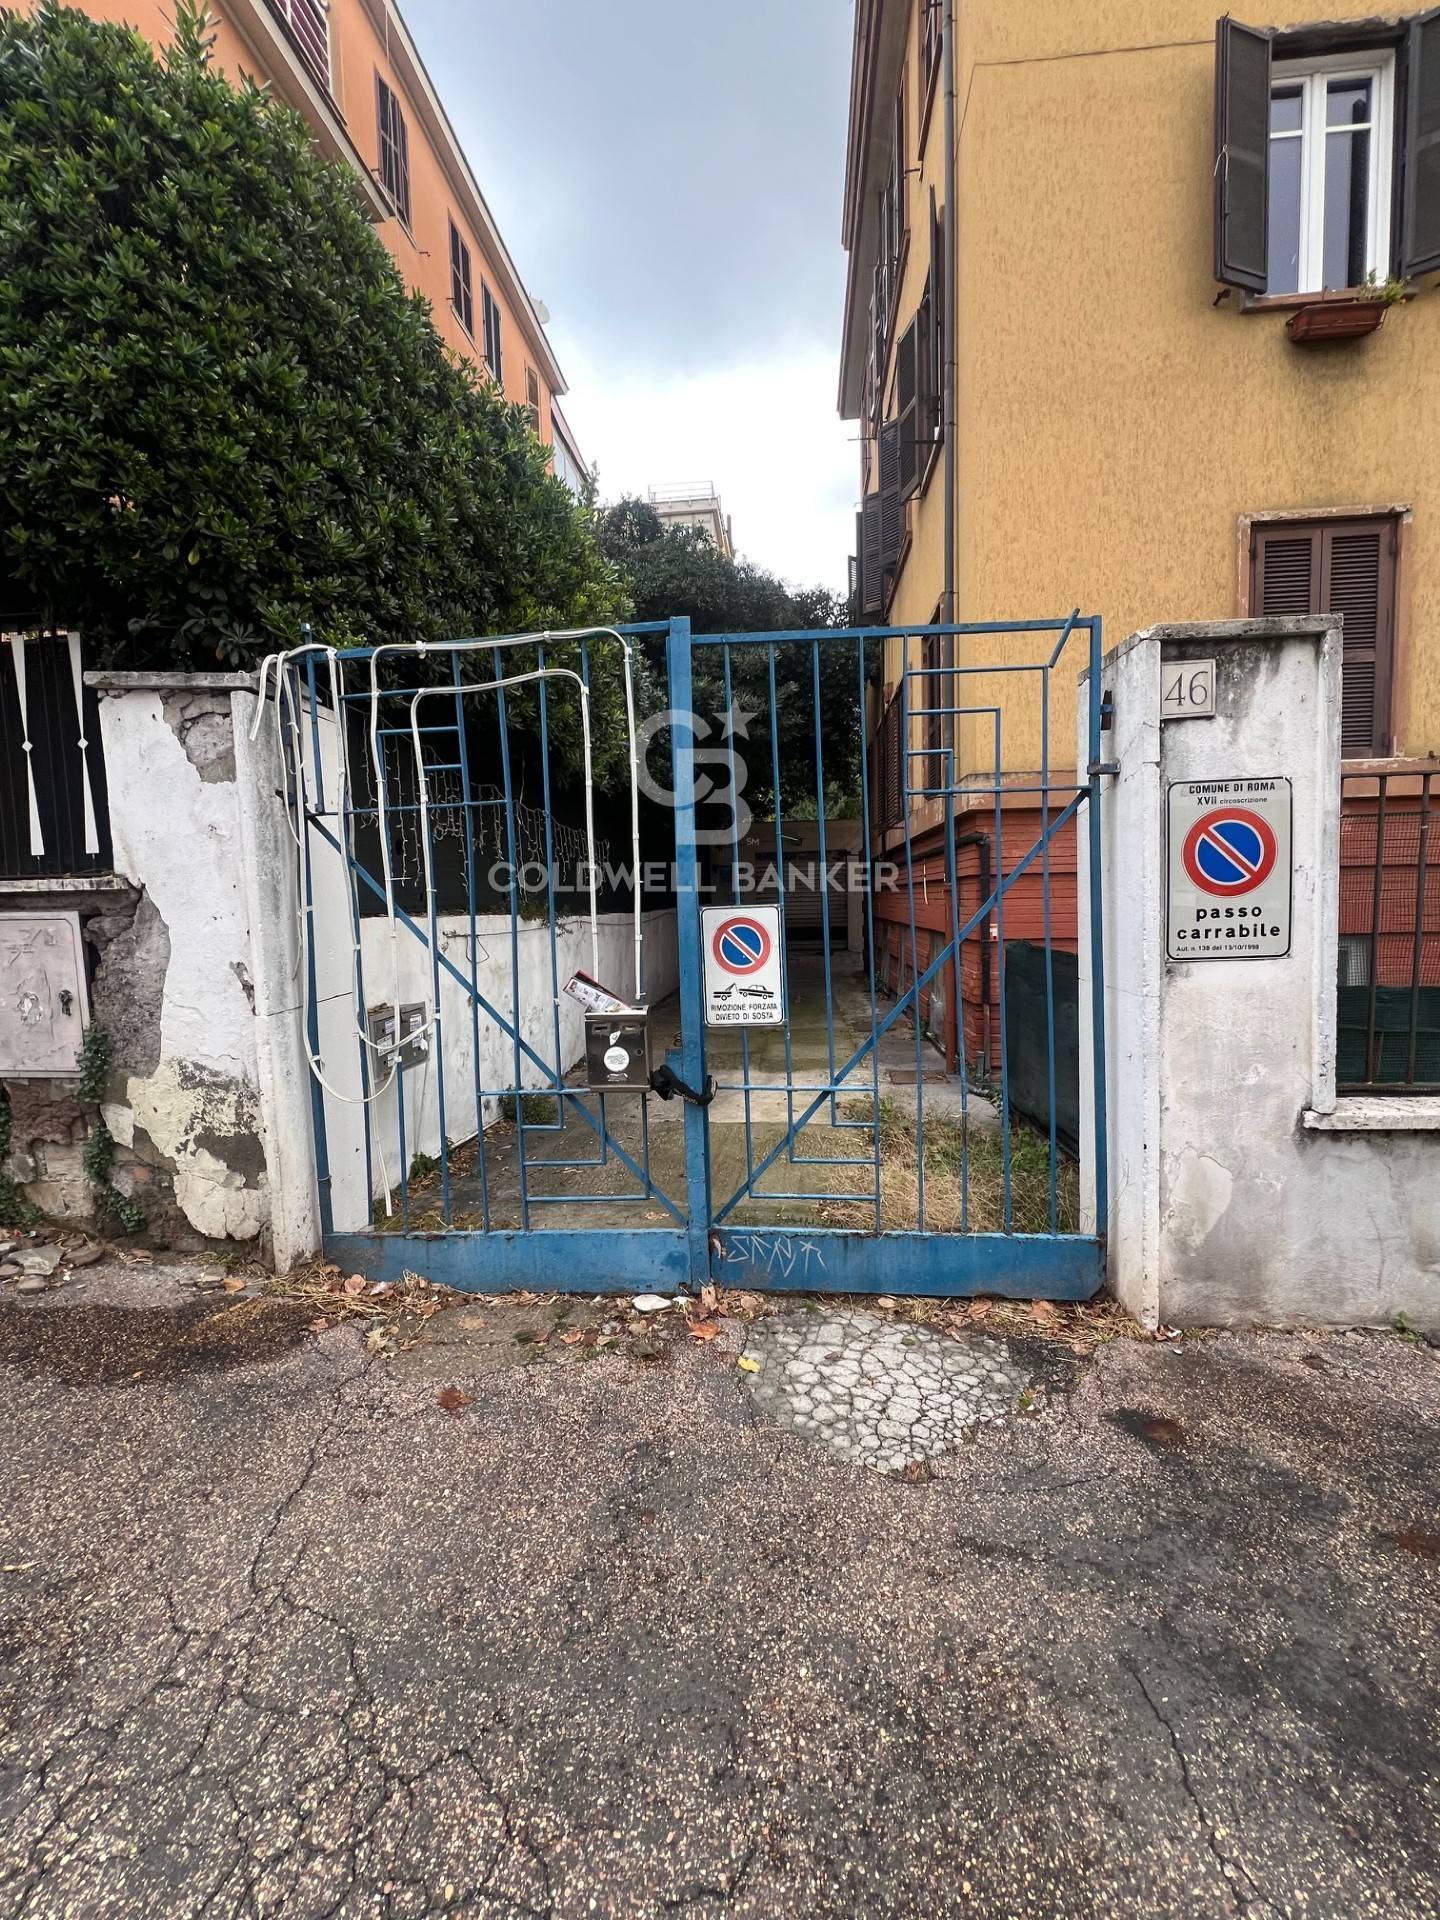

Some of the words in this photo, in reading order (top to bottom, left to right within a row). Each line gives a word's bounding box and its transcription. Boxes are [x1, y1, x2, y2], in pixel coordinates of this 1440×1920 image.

[1164, 671, 1209, 706] 46
[1189, 783, 1230, 794] COMUNE
[1233, 783, 1243, 792] DI
[1247, 782, 1276, 791] ROMA
[1219, 797, 1268, 805] circoscrizione
[1196, 906, 1262, 922] passo
[1177, 923, 1281, 940] carrabile
[748, 1003, 778, 1011] FORZATA
[715, 1013, 740, 1021] DIVIETO
[742, 1012, 750, 1020] DI
[751, 1011, 774, 1020] SOSTA
